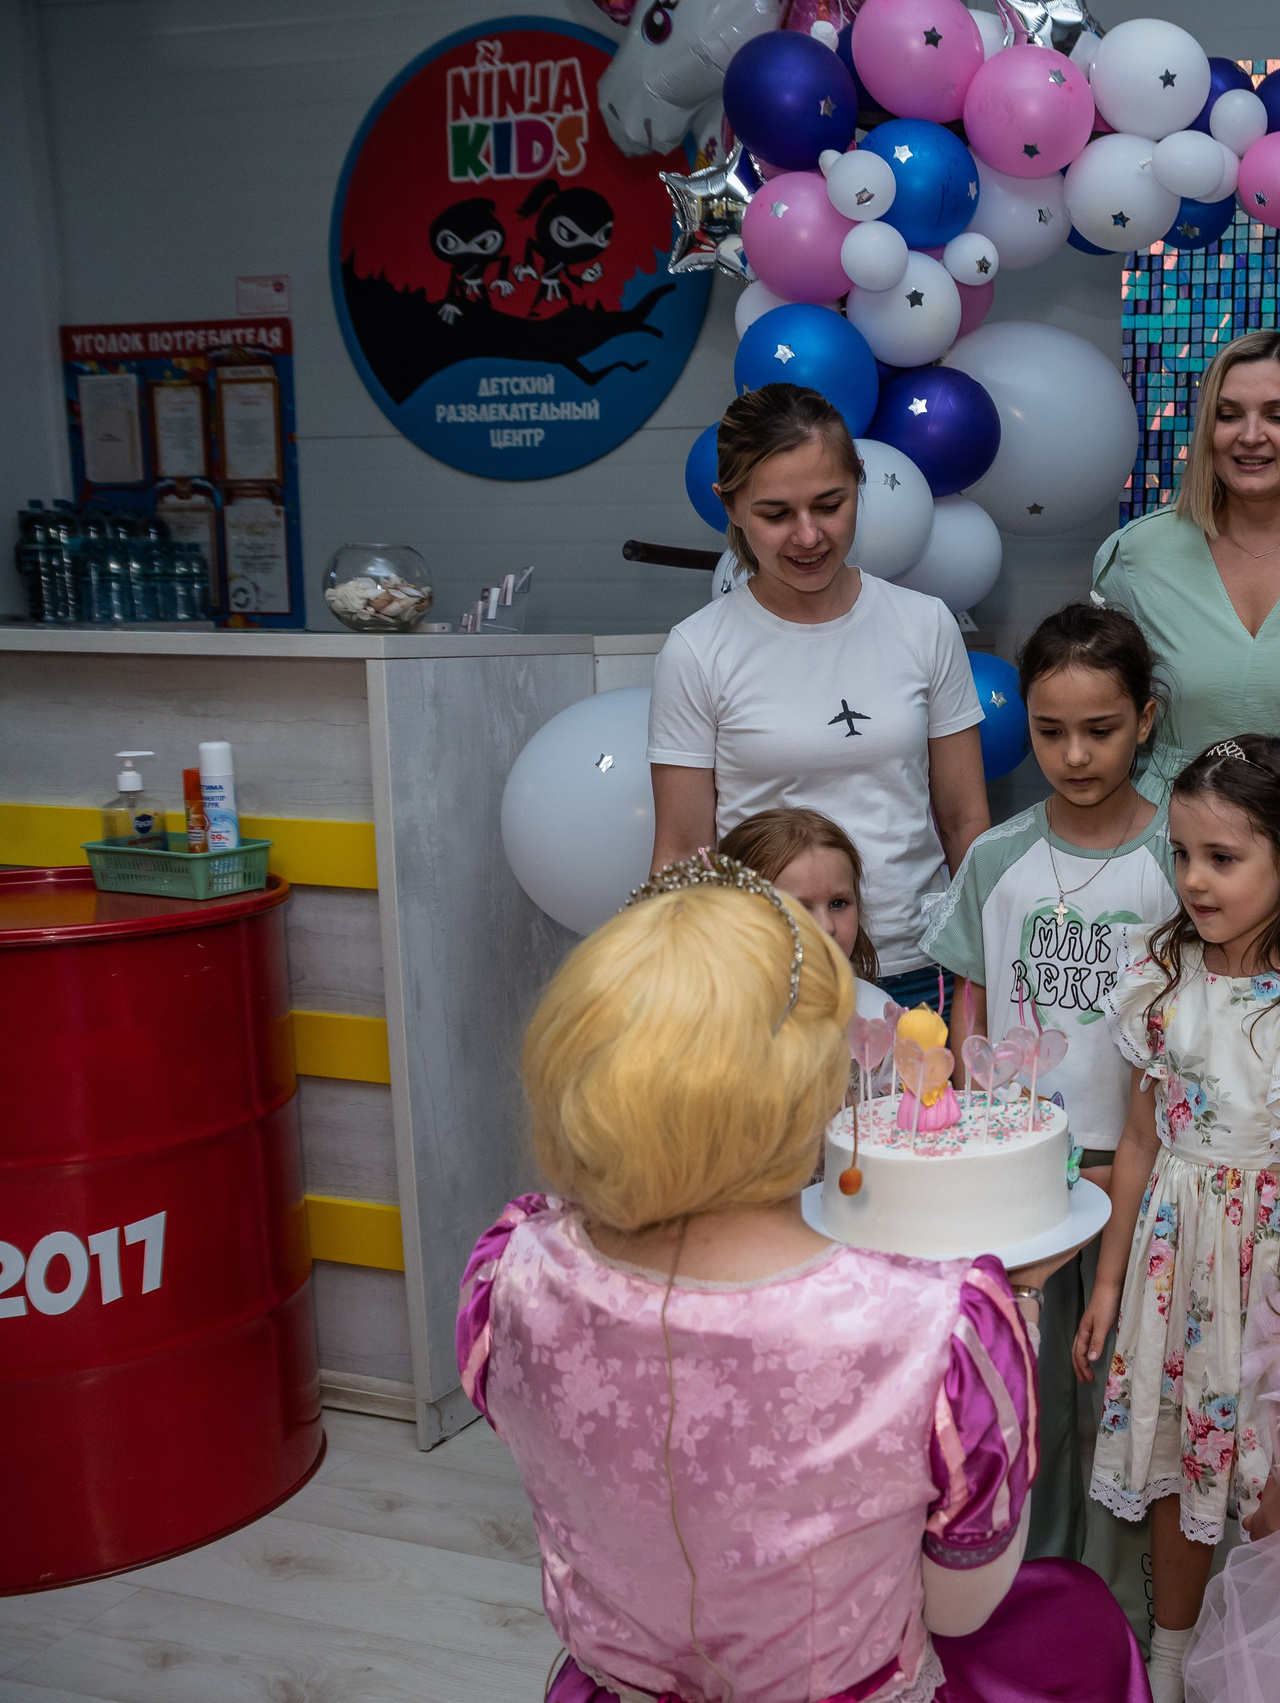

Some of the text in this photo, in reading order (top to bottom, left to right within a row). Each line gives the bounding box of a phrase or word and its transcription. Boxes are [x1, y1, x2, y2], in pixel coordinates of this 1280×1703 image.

[447, 41, 588, 121] NINJA
[449, 115, 587, 183] KIDS
[71, 326, 282, 355] УГОЛОК ПОТРЕБИТЕЛЯ
[477, 373, 555, 397] ДЕТСКИЙ
[436, 398, 600, 423] РАЗВЛЕКАТЕЛЬНЫЙ
[490, 428, 545, 449] ЦЕНТР
[1030, 915, 1119, 966] MAK
